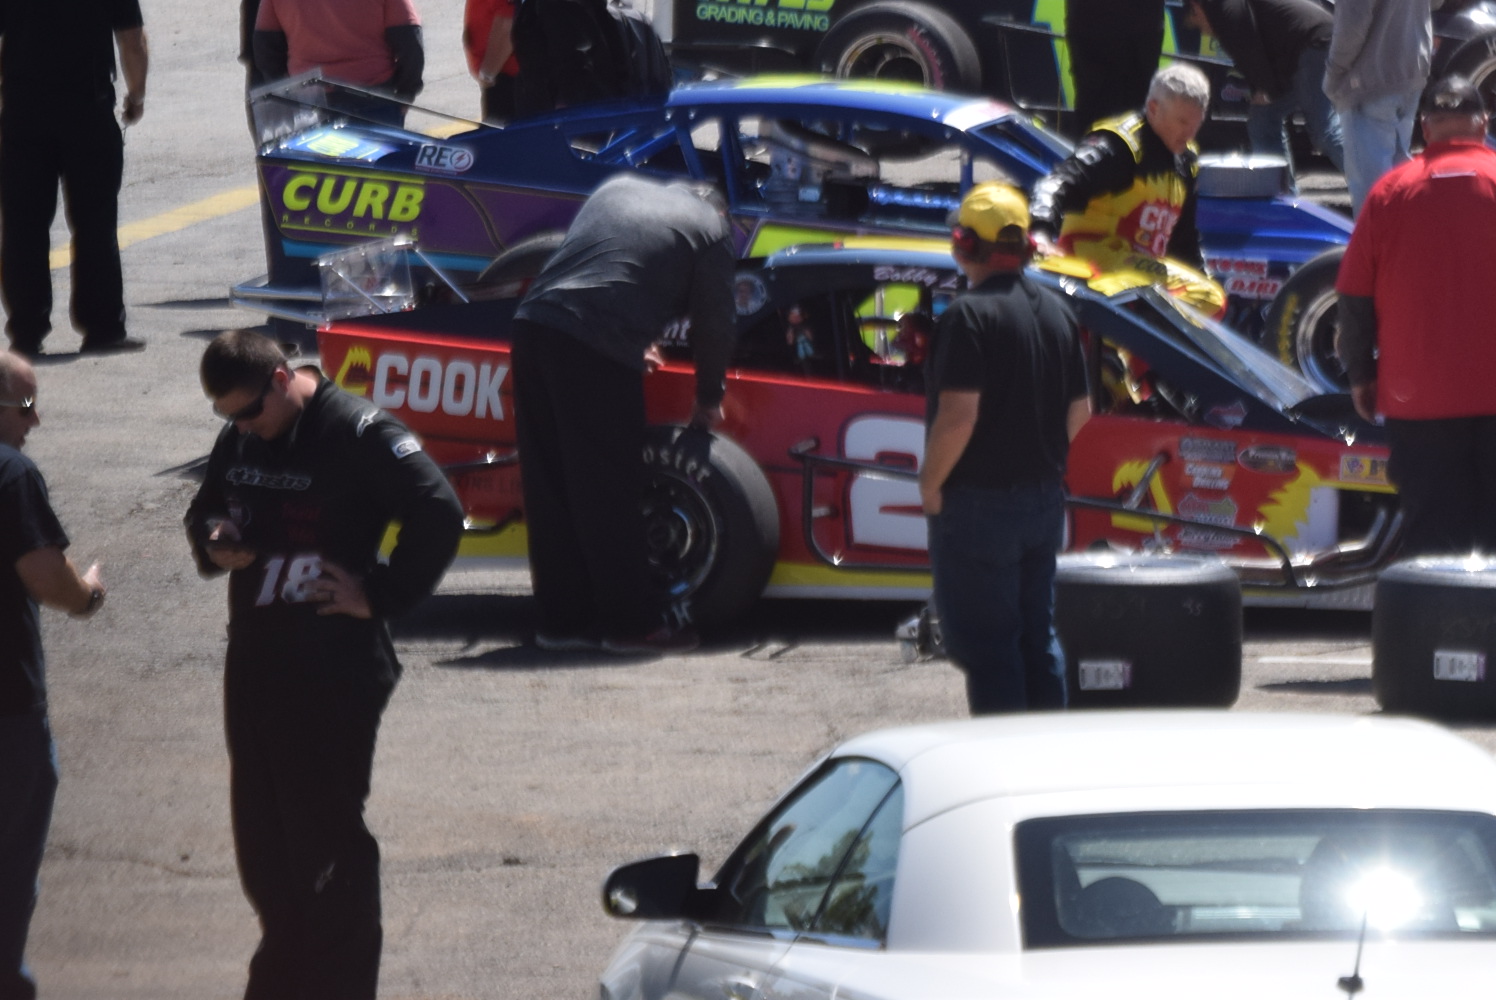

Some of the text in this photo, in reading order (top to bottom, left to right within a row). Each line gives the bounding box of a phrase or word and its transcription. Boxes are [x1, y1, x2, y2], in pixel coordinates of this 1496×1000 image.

[697, 5, 829, 31] GRADING & PAVING
[283, 174, 425, 223] CURB
[282, 215, 418, 236] RECORDS
[373, 353, 509, 421] COOK
[255, 554, 322, 607] 18
